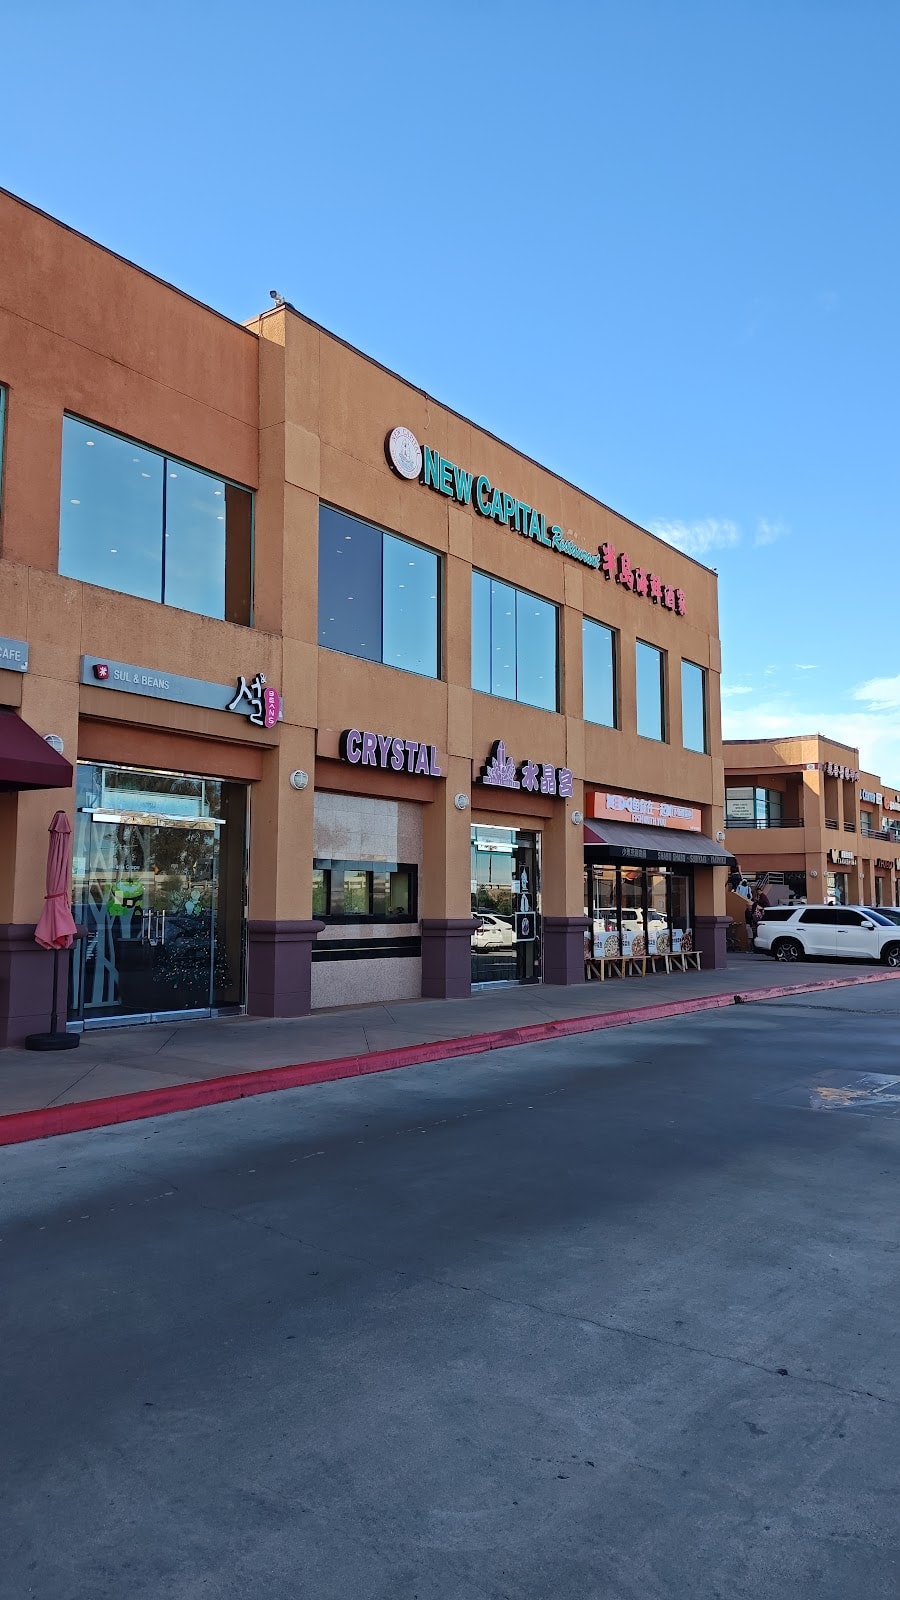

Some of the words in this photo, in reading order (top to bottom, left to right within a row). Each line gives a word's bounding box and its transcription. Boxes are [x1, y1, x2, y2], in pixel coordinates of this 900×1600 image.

[423, 445, 474, 505] NEW
[476, 474, 551, 547] CAPITAL
[113, 669, 130, 682] SUL
[133, 674, 140, 684] &
[141, 675, 170, 690] BEANS
[260, 672, 267, 684] &
[346, 729, 441, 776] CRYSTAL
